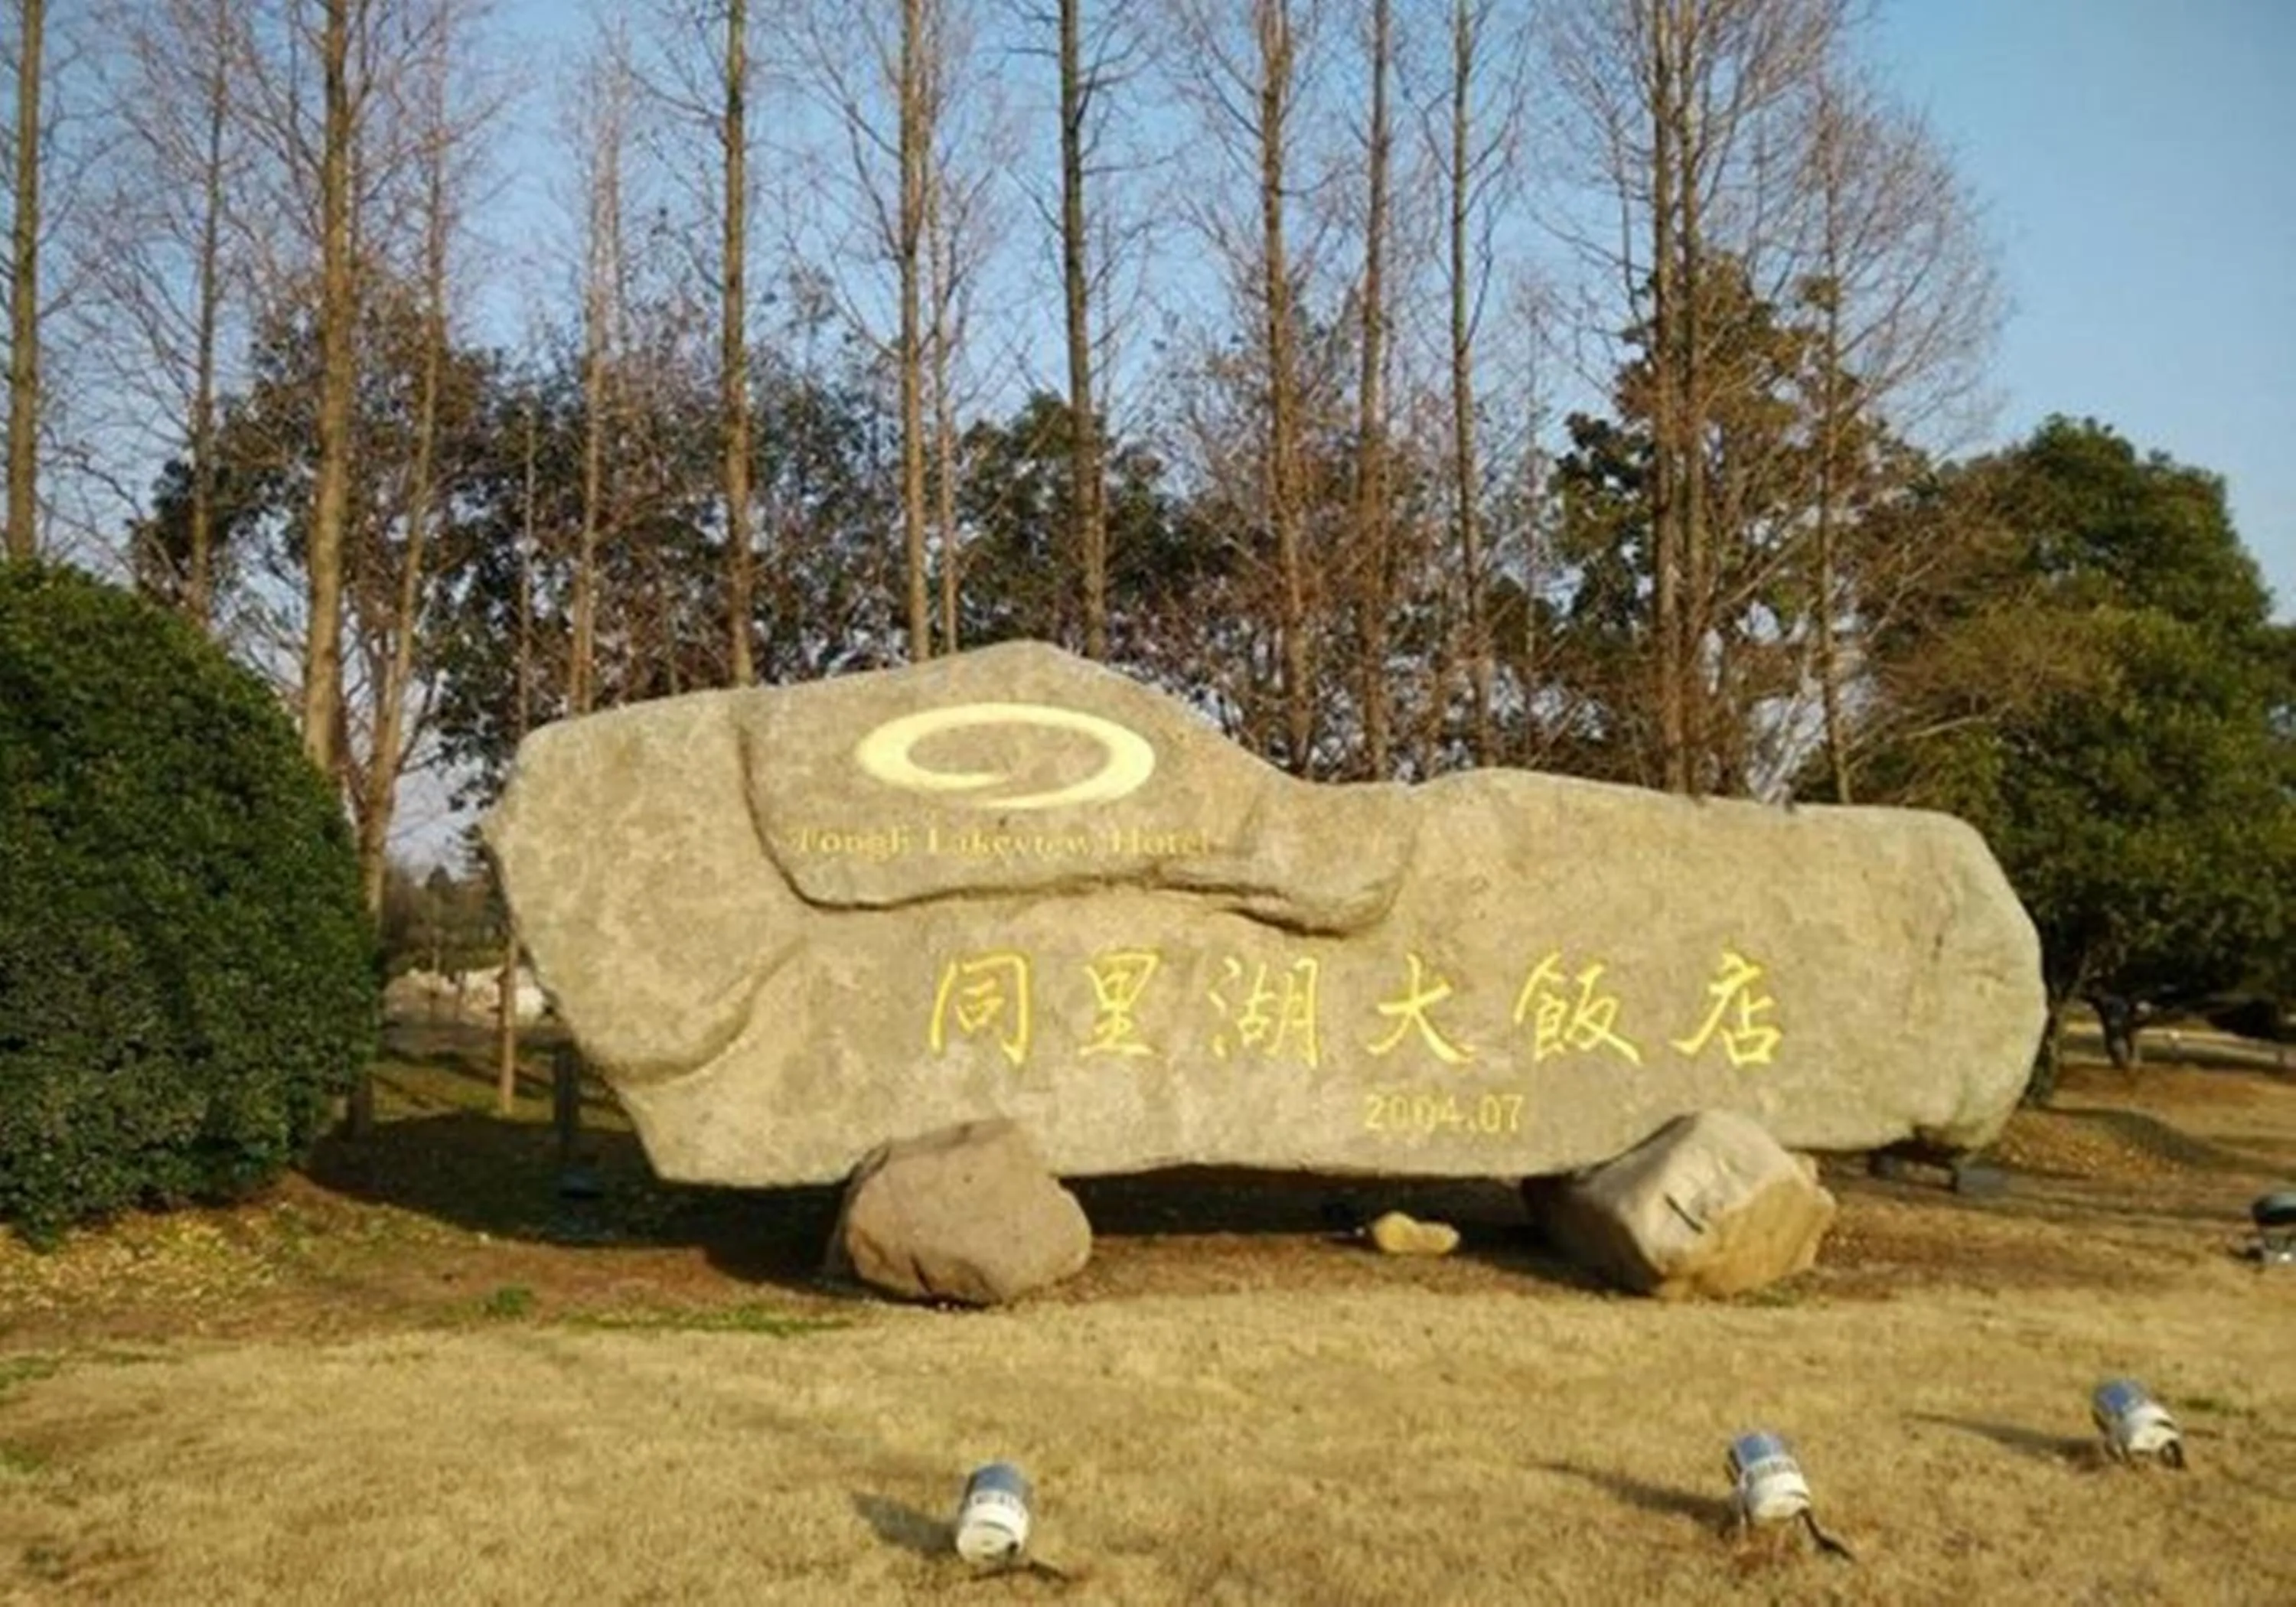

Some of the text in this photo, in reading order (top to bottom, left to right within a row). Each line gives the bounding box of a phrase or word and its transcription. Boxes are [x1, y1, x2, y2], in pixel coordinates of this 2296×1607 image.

[928, 951, 1782, 1067] 同里湖大飯店
[1364, 1092, 1525, 1134] 2004.07
